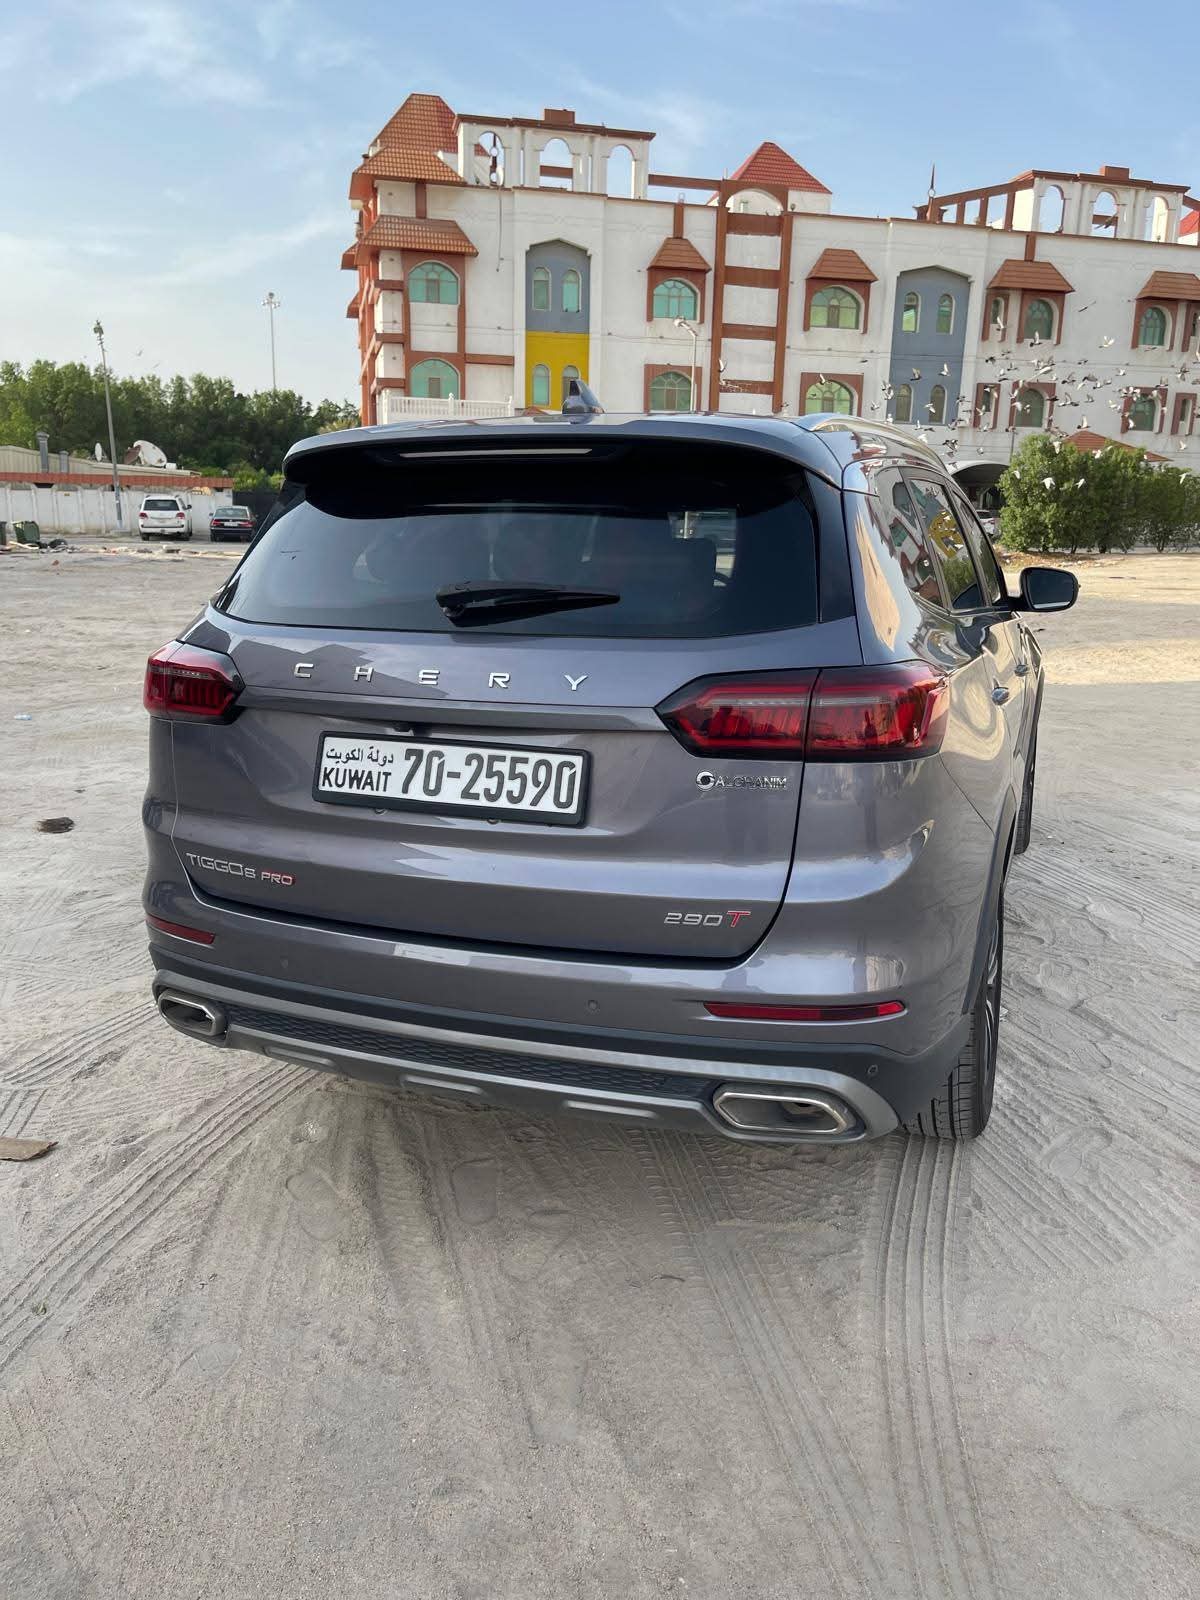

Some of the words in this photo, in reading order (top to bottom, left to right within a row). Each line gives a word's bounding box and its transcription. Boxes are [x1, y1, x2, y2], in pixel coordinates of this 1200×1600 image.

[293, 662, 588, 691] CHERY
[326, 748, 363, 764] الكويت
[367, 746, 394, 766] دولة
[321, 767, 392, 792] KUWAIT
[401, 748, 577, 809] 70-25590
[261, 871, 293, 885] PRO
